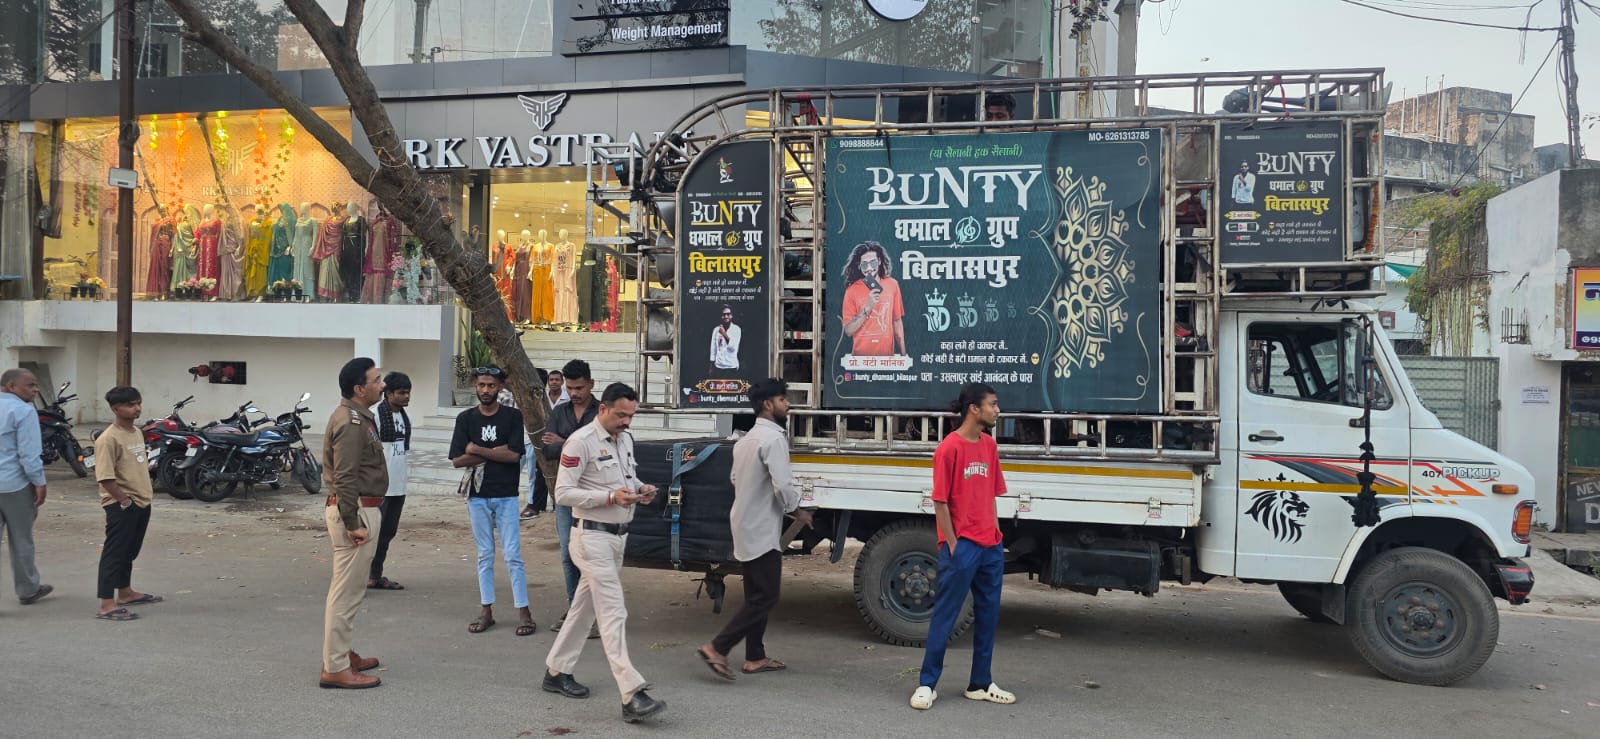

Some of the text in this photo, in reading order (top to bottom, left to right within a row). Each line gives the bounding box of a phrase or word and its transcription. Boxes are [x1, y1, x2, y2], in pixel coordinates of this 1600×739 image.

[611, 21, 722, 41] Weight Management
[840, 138, 884, 148] 9098888844
[1105, 130, 1150, 141] 6261313785
[402, 138, 467, 169] RK
[1255, 151, 1337, 177] BUNTY
[865, 164, 1043, 210] BUNTY
[1269, 180, 1296, 192] धमाल
[689, 200, 763, 228] BUNTY
[1263, 195, 1331, 216] बिलासपुर
[688, 230, 764, 252] धमाल ग्रुप
[894, 216, 1020, 249] धमाल ग्रुप
[688, 251, 763, 279] बिलासपुर
[899, 250, 1022, 288] बिलासपुर
[1422, 466, 1500, 479] 407 PICKUP
